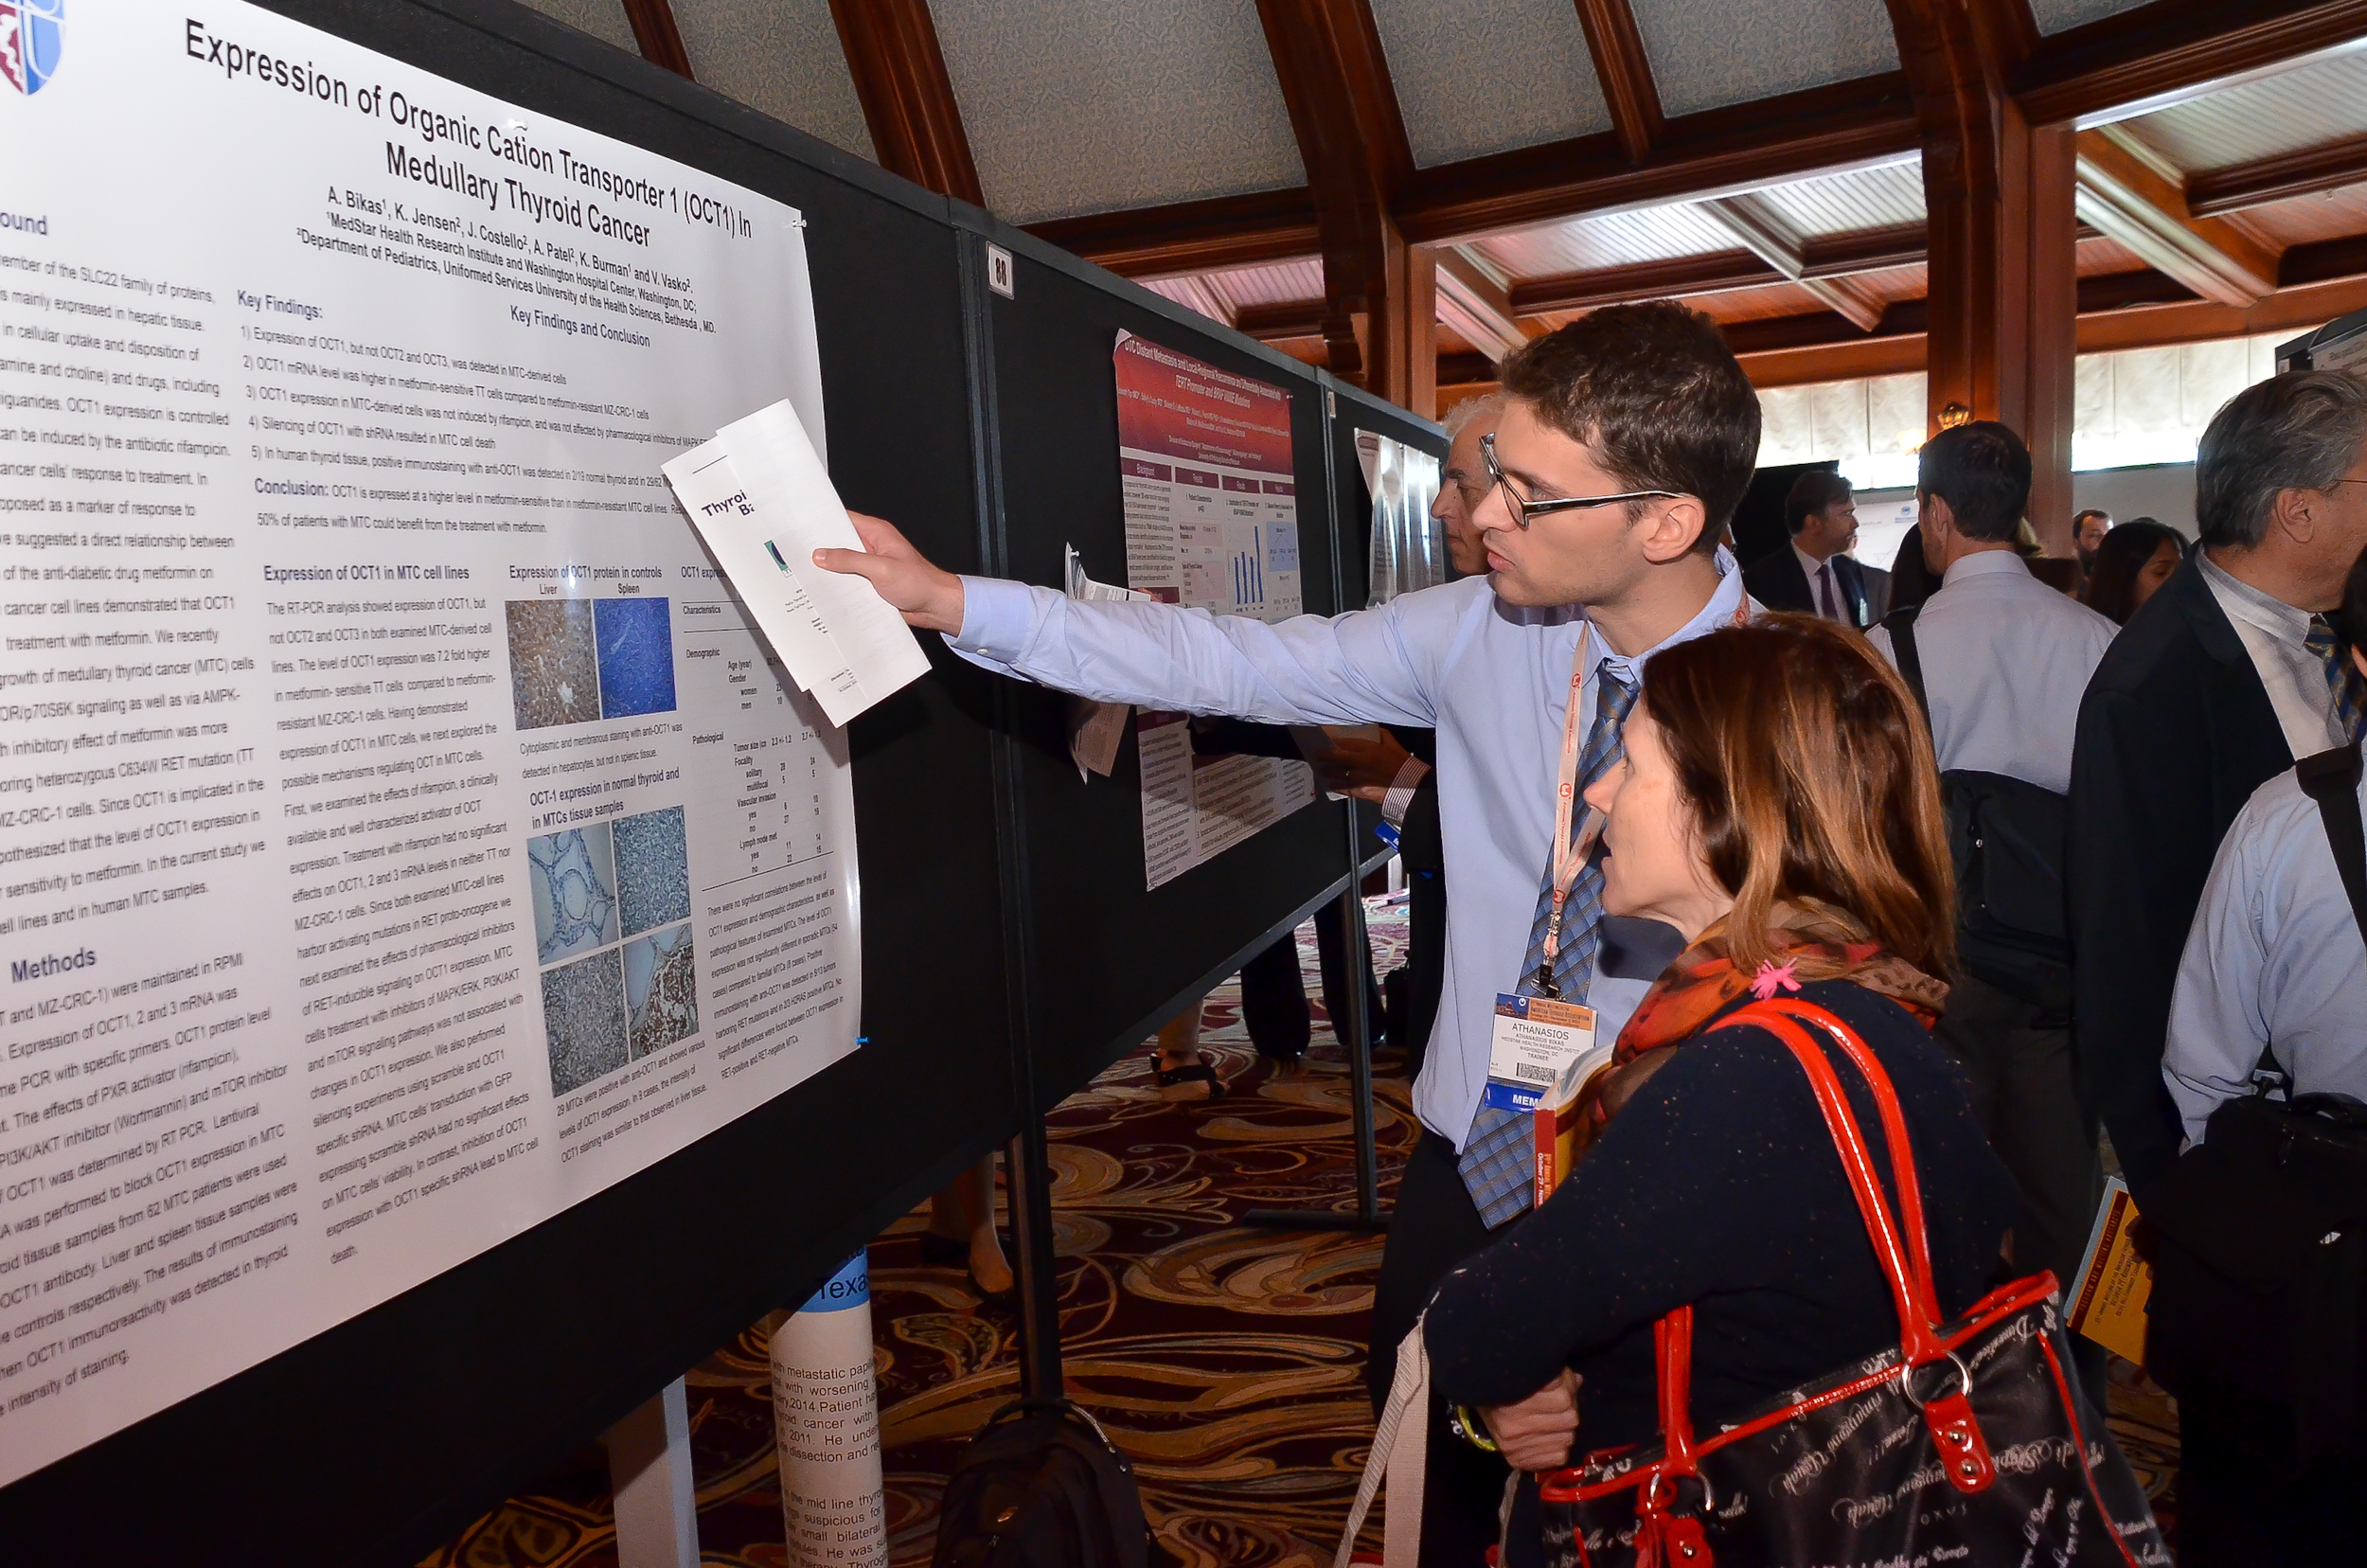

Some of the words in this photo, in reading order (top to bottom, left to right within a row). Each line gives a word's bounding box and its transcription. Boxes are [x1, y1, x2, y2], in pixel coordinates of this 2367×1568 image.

[186, 17, 347, 107] Expression
[357, 84, 382, 117] of
[389, 91, 481, 150] Organic
[487, 125, 554, 174] Cation
[558, 148, 665, 209] Transporter
[669, 187, 677, 213] 1
[684, 190, 735, 239] (OCT1)
[738, 210, 752, 239] In
[385, 140, 498, 211] Medullary
[504, 177, 582, 228] Thyroid
[587, 204, 650, 247] Cancer
[0, 205, 47, 236] ound
[328, 186, 342, 205] A.
[394, 202, 408, 222] K.
[467, 221, 477, 239] J.
[533, 239, 544, 256] A.
[578, 250, 591, 268] K.
[633, 269, 650, 283] and
[650, 269, 660, 286] V.
[379, 223, 414, 245] Health
[416, 232, 465, 257] Research
[466, 244, 504, 266] Institute
[506, 257, 523, 271] and
[524, 258, 575, 283] Washington
[575, 271, 609, 292] Hospital
[609, 280, 637, 300] Center,
[637, 287, 682, 311] Washington,
[683, 297, 697, 314] DC;
[370, 245, 382, 259] of
[384, 246, 440, 275] Pediatrics,
[442, 259, 493, 284] Uniformed
[494, 272, 534, 293] Services
[534, 280, 578, 306] University
[578, 292, 587, 305] of
[588, 294, 602, 309] the
[602, 296, 628, 314] Health
[629, 302, 664, 324] Sciences,
[664, 311, 698, 330] Bethesda
[703, 319, 716, 333] MD.
[237, 289, 261, 312] Key
[265, 294, 323, 321] Findings:
[509, 304, 531, 328] Key
[533, 309, 578, 335] Findings
[579, 322, 598, 337] and
[599, 323, 650, 347] Conclusion
[248, 415, 258, 430] 4)
[261, 416, 305, 436] Silencing
[306, 420, 316, 433] of
[317, 420, 344, 436] OCT1
[346, 425, 364, 437] with
[365, 426, 395, 440] shRNA
[395, 431, 428, 444] resulted
[428, 432, 436, 444] in
[437, 433, 458, 446] MTC
[458, 436, 473, 447] cell
[473, 436, 496, 449] death
[254, 477, 329, 496] Conclusion:
[701, 489, 747, 516] Thyroi
[263, 564, 333, 584] Expression
[335, 564, 347, 580] of
[349, 564, 381, 580] OCT1
[383, 565, 395, 579] in
[397, 564, 420, 579] MTC
[423, 564, 442, 579] cell
[444, 565, 470, 579] lines
[508, 564, 559, 581] Expression
[561, 564, 569, 578] of
[570, 565, 591, 579] OCT1
[593, 565, 620, 581] protein
[621, 565, 630, 579] in
[631, 565, 662, 579] controls
[680, 565, 700, 578] OCT1
[539, 583, 558, 595] Liver
[617, 582, 640, 596] Spleen
[682, 604, 721, 615] Characteristics
[685, 647, 721, 659] Demographic
[727, 660, 738, 671] Age
[738, 659, 752, 671] (year)
[728, 672, 747, 684] Gender
[739, 687, 757, 696] women
[692, 731, 724, 744] Pathological
[529, 789, 557, 806] OCT-1
[559, 781, 602, 803] expression
[602, 779, 611, 793] in
[611, 774, 636, 791] normal
[637, 769, 664, 788] thyroid
[665, 766, 680, 780] and
[531, 815, 541, 829] in
[543, 811, 568, 827] MTCs
[568, 807, 594, 822] tissue
[594, 799, 624, 816] samples
[10, 947, 96, 984] Methods
[1512, 1023, 1569, 1040] ATHANASIOS
[1527, 1053, 1549, 1061] TRAINEE
[1512, 1094, 1541, 1106] MEM
[787, 1366, 845, 1381] metastatic
[785, 1381, 803, 1394] with
[809, 1379, 869, 1397] worsening
[803, 1418, 845, 1430] cancer
[853, 1410, 873, 1426] with
[789, 1429, 815, 1445] 2011.
[824, 1434, 843, 1446] He
[789, 1446, 843, 1462] dissection
[846, 1445, 868, 1460] and
[807, 1497, 827, 1509] mid
[831, 1498, 854, 1509] line
[804, 1513, 865, 1527] suspicious
[870, 1506, 881, 1519] for
[801, 1528, 828, 1541] small
[837, 1522, 881, 1542] bilateral
[827, 1547, 845, 1559] He
[849, 1544, 873, 1558] was
